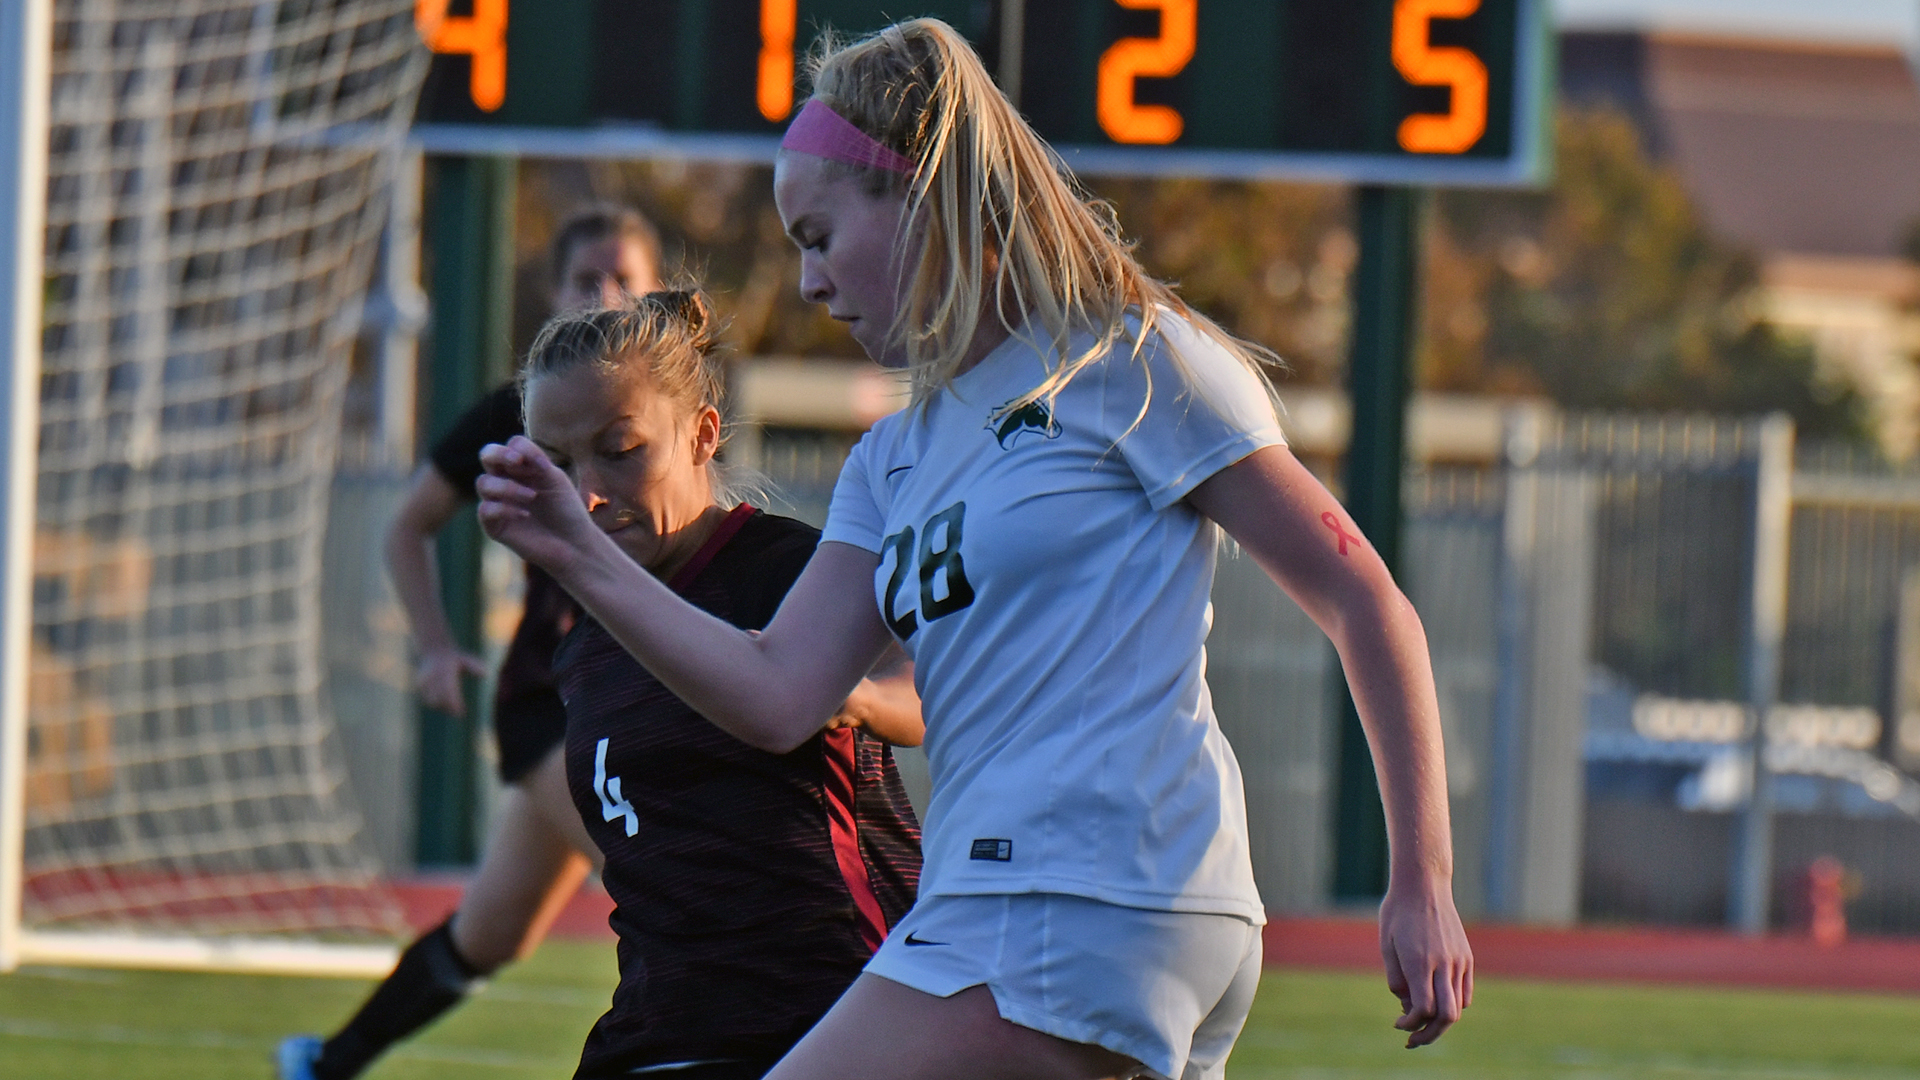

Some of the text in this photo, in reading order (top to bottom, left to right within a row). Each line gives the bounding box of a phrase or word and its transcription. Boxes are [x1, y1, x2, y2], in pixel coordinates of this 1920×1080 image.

[1097, 0, 1197, 144] 2
[1391, 0, 1488, 153] 5
[880, 501, 976, 642] 28
[593, 737, 639, 838] 4
